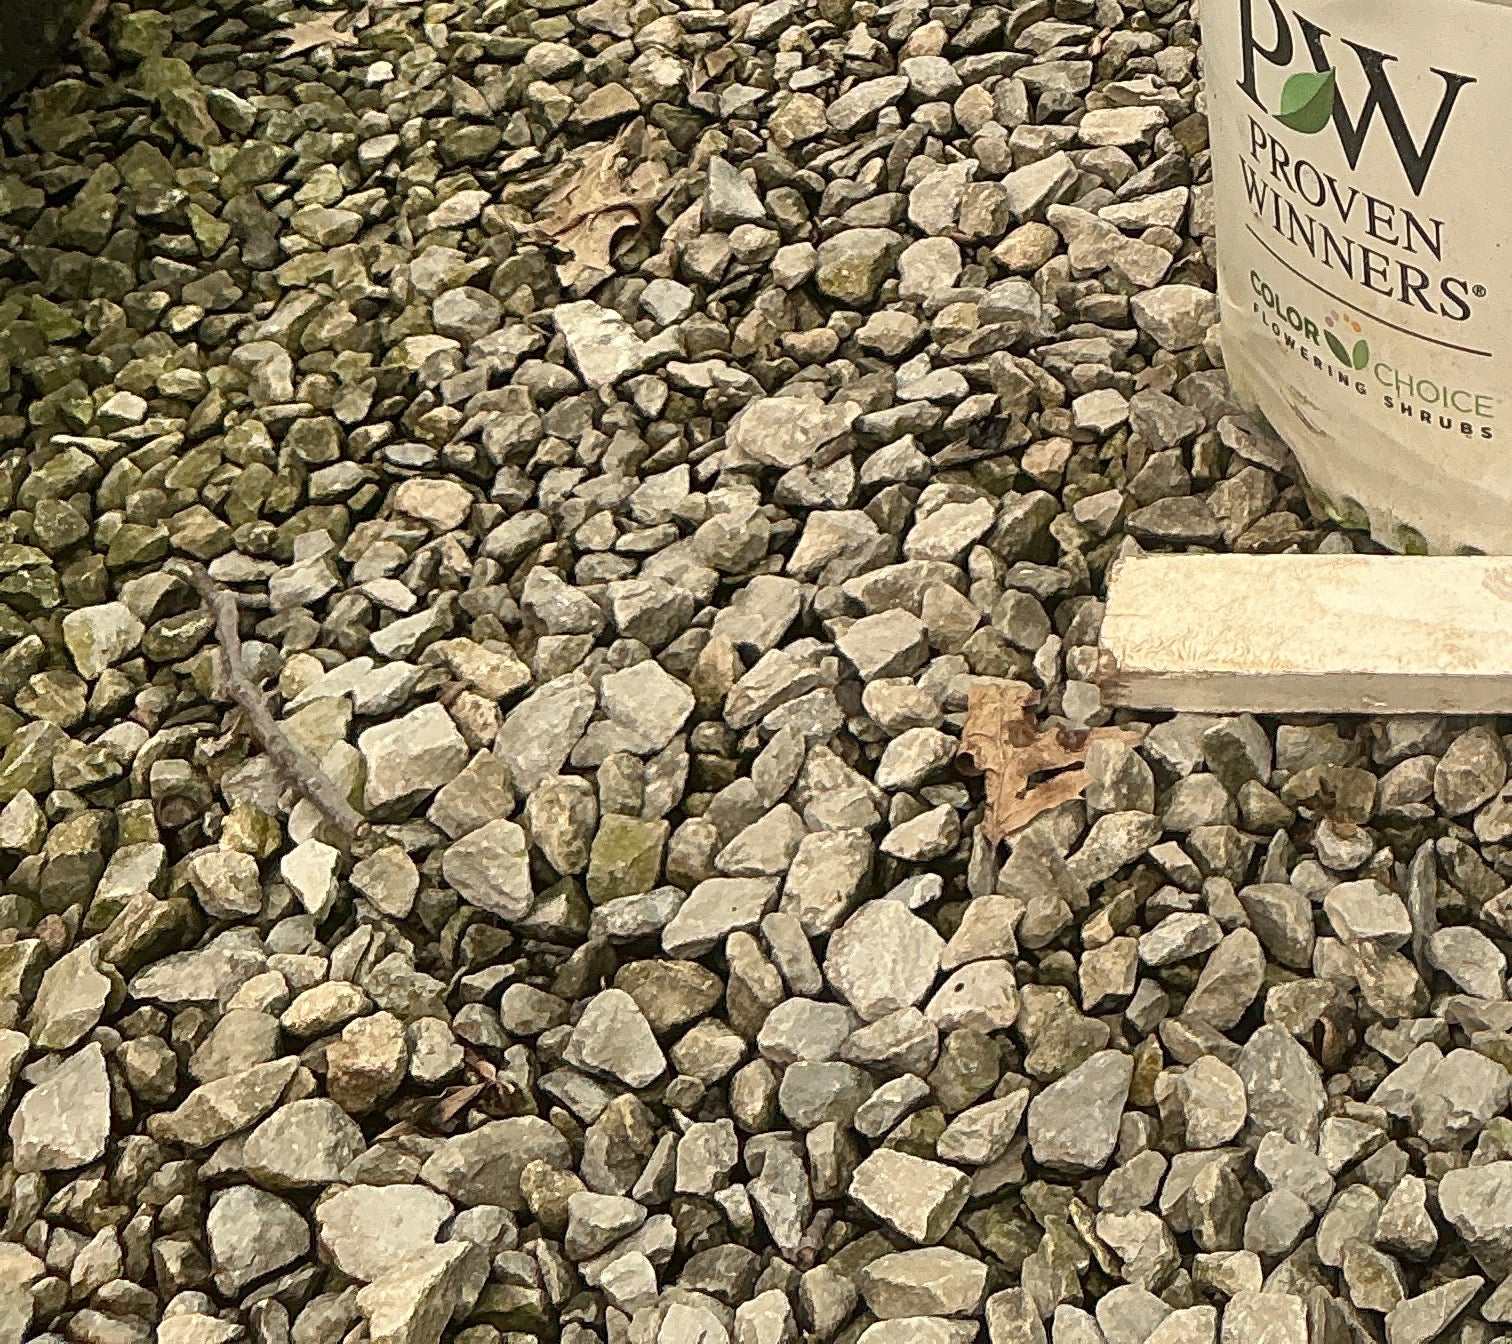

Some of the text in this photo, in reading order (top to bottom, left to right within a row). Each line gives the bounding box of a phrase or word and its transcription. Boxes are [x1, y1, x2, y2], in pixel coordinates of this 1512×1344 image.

[1247, 113, 1446, 262] PROVEN
[1249, 269, 1495, 419] COLOR CHOICE
[1253, 301, 1494, 441] FLOWERING SHRUBS
